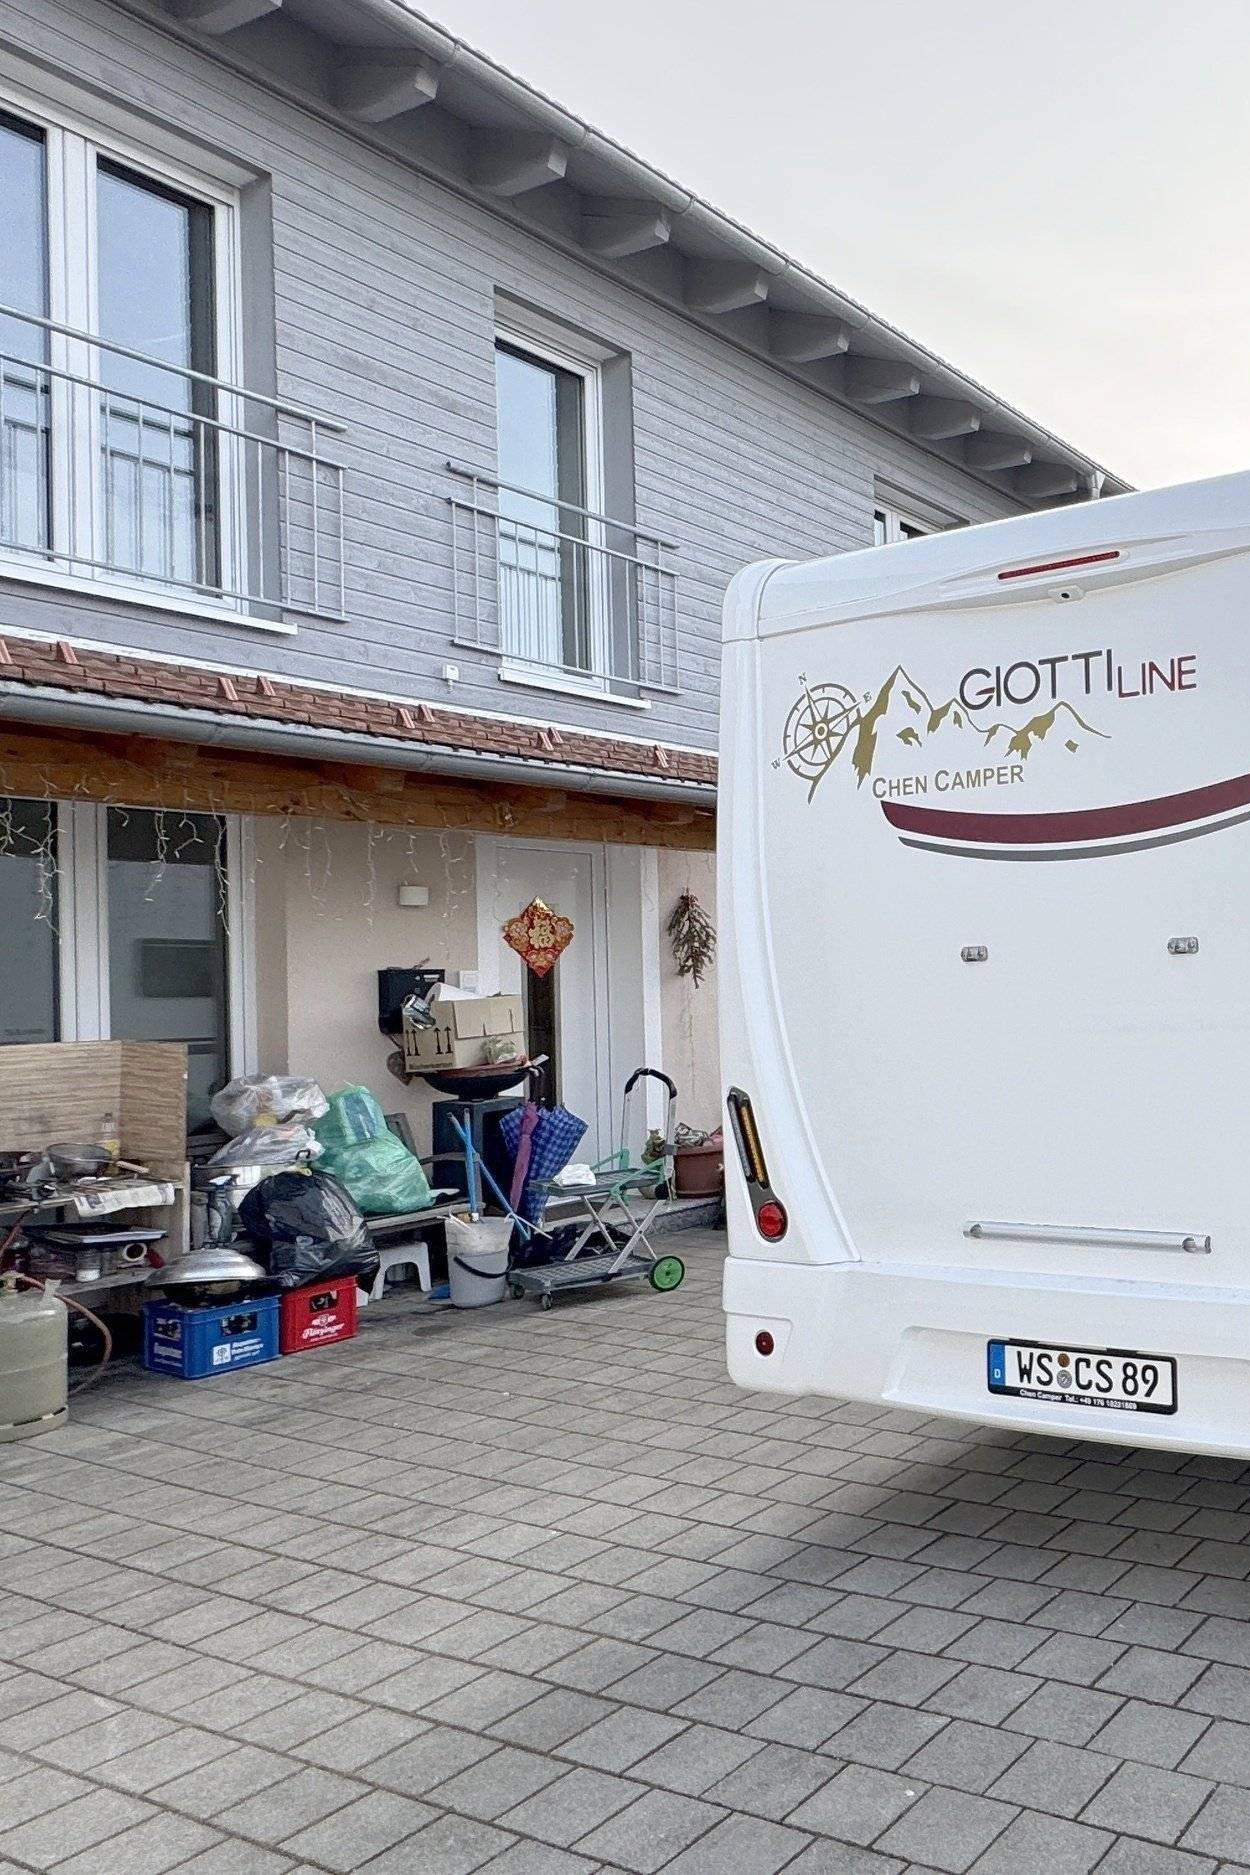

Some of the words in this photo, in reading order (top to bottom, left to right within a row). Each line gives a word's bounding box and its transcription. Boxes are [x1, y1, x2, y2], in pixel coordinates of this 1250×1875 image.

[872, 775, 927, 799] CHEN
[934, 764, 1025, 792] CAMPER
[994, 1368, 1001, 1379] D
[1016, 1350, 1054, 1387] WS
[1074, 1357, 1114, 1394] CS
[1121, 1361, 1159, 1398] 89
